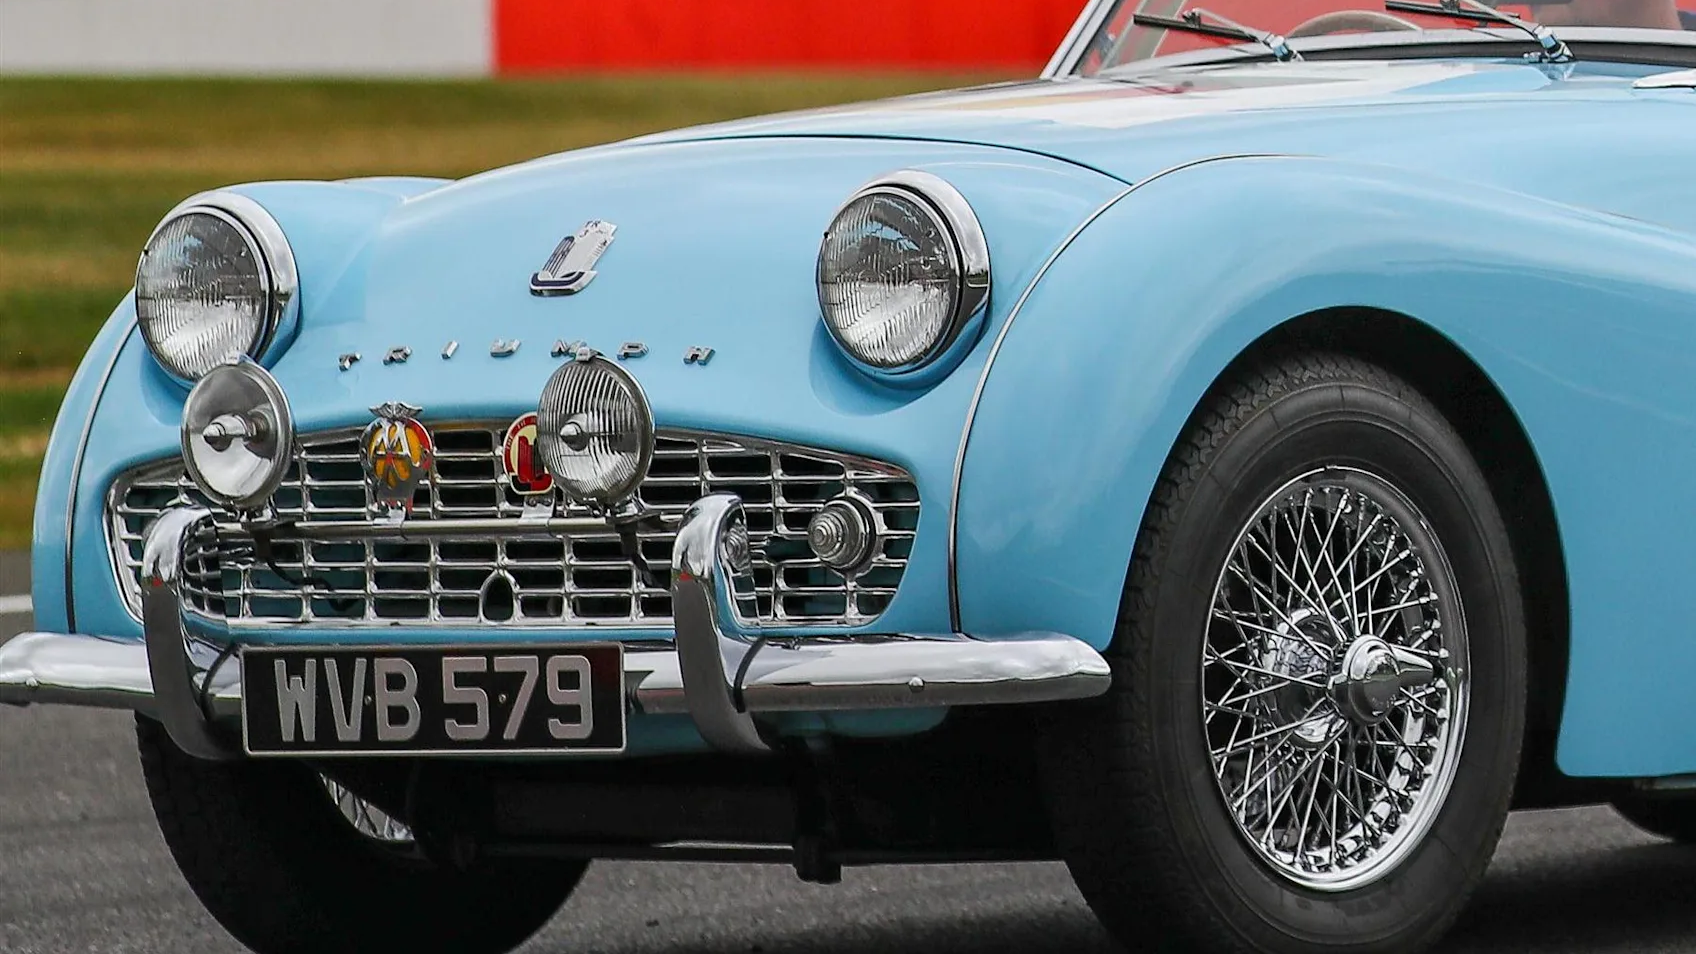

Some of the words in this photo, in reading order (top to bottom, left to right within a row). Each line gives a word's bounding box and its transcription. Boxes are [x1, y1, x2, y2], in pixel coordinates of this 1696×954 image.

[338, 339, 717, 372] TRIUMPH
[273, 657, 421, 743] WVB
[442, 654, 594, 741] 579
